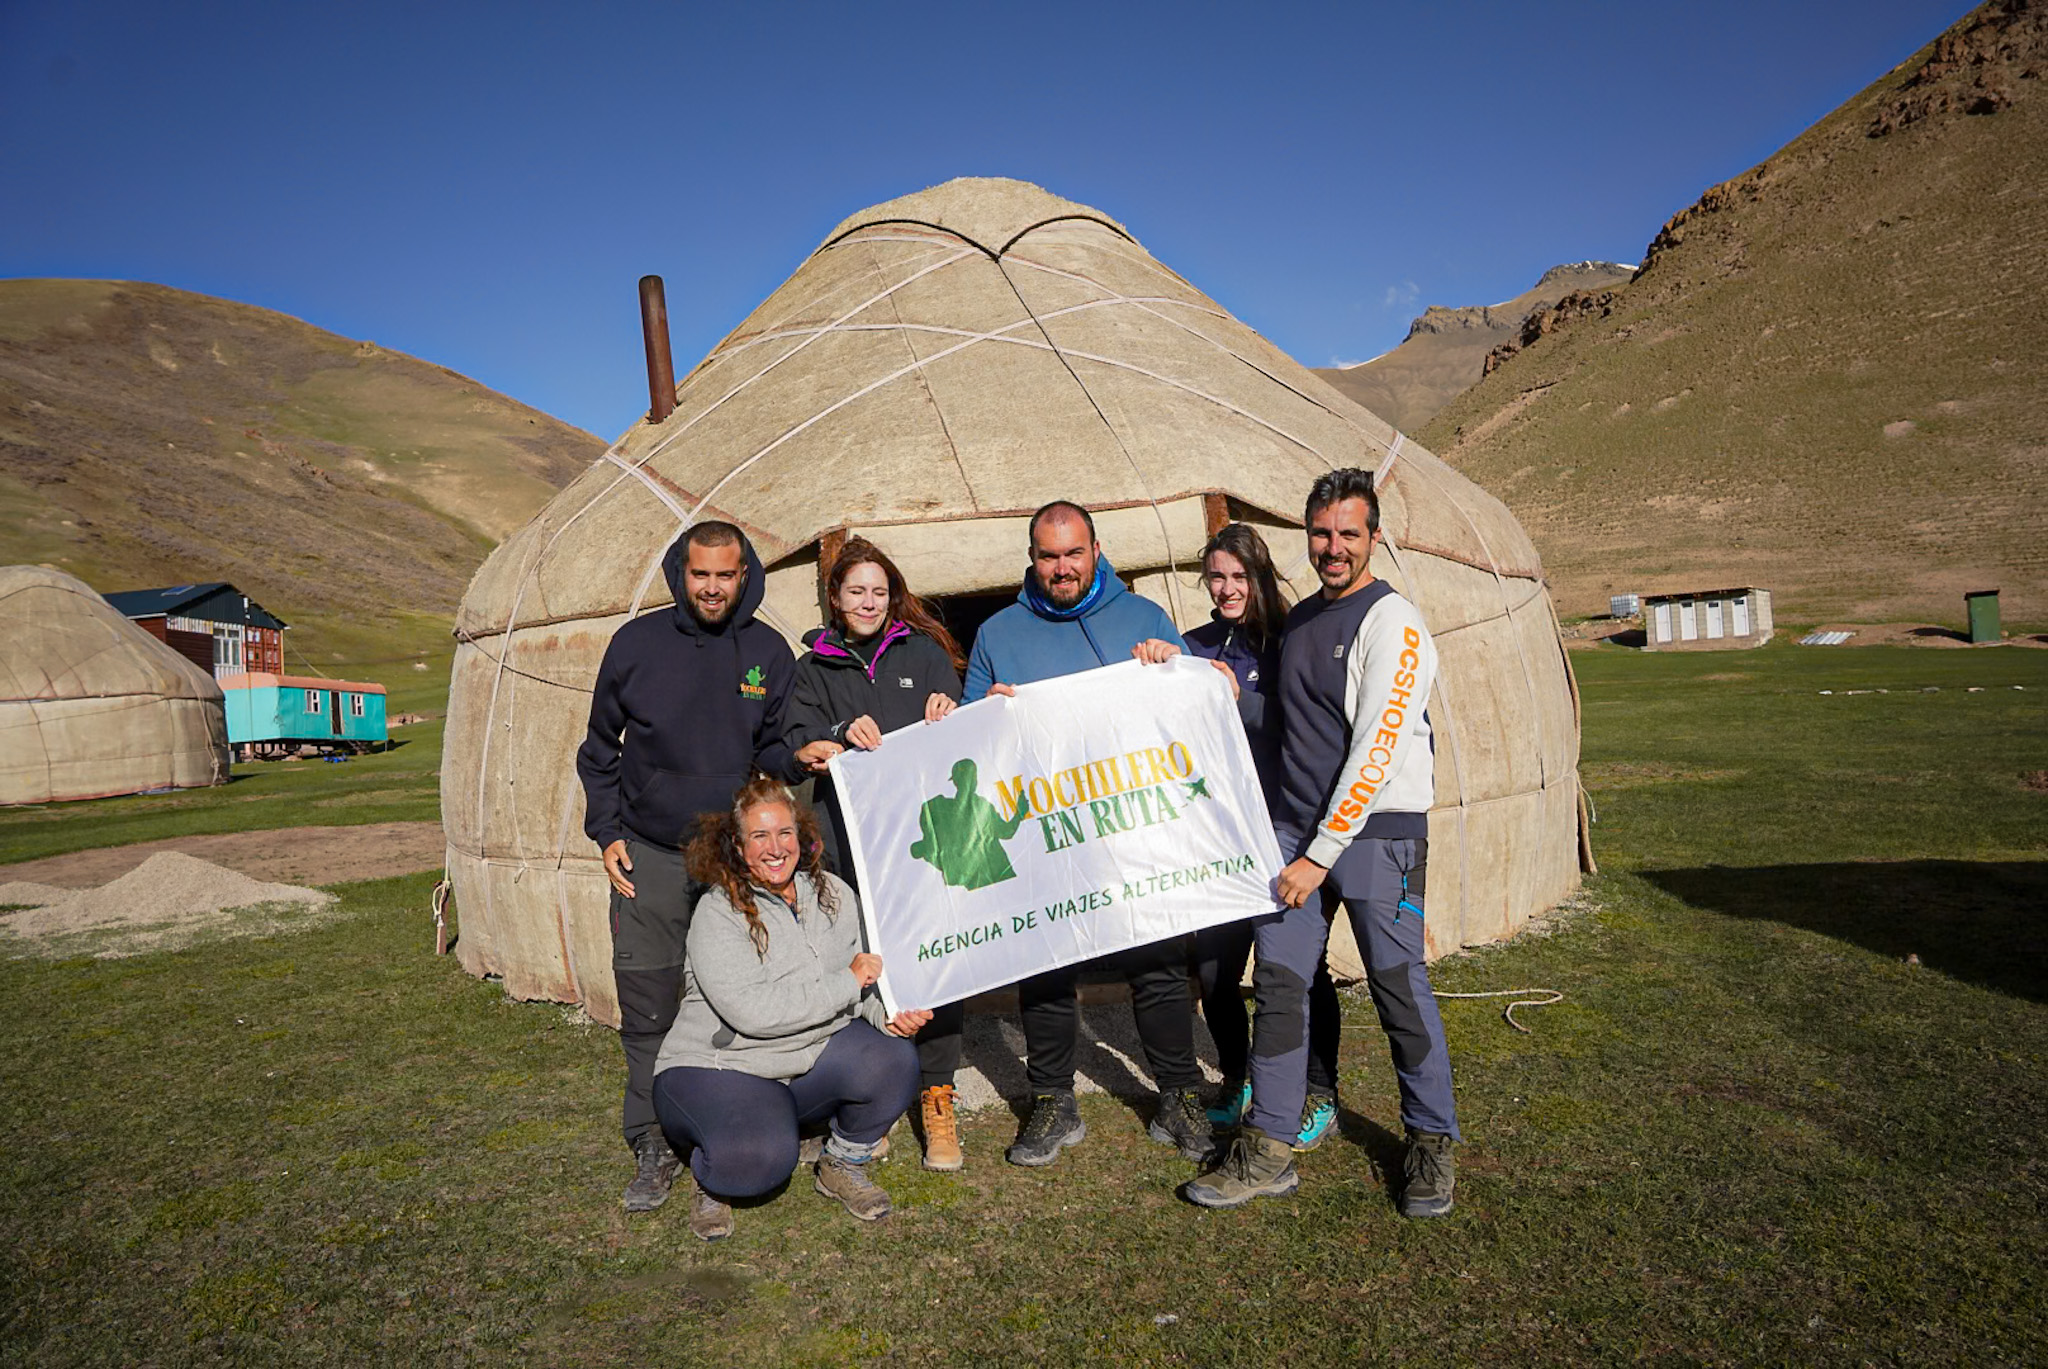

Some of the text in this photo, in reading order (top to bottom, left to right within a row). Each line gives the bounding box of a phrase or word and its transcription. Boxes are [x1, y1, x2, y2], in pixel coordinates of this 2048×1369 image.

[1327, 626, 1420, 832] DCSHOECOUSA
[994, 741, 1194, 822] MOCHILERO
[1037, 785, 1180, 854] EN RUTA
[917, 853, 1255, 961] AGENCIA DE VIAJES ALTERNATIVA
